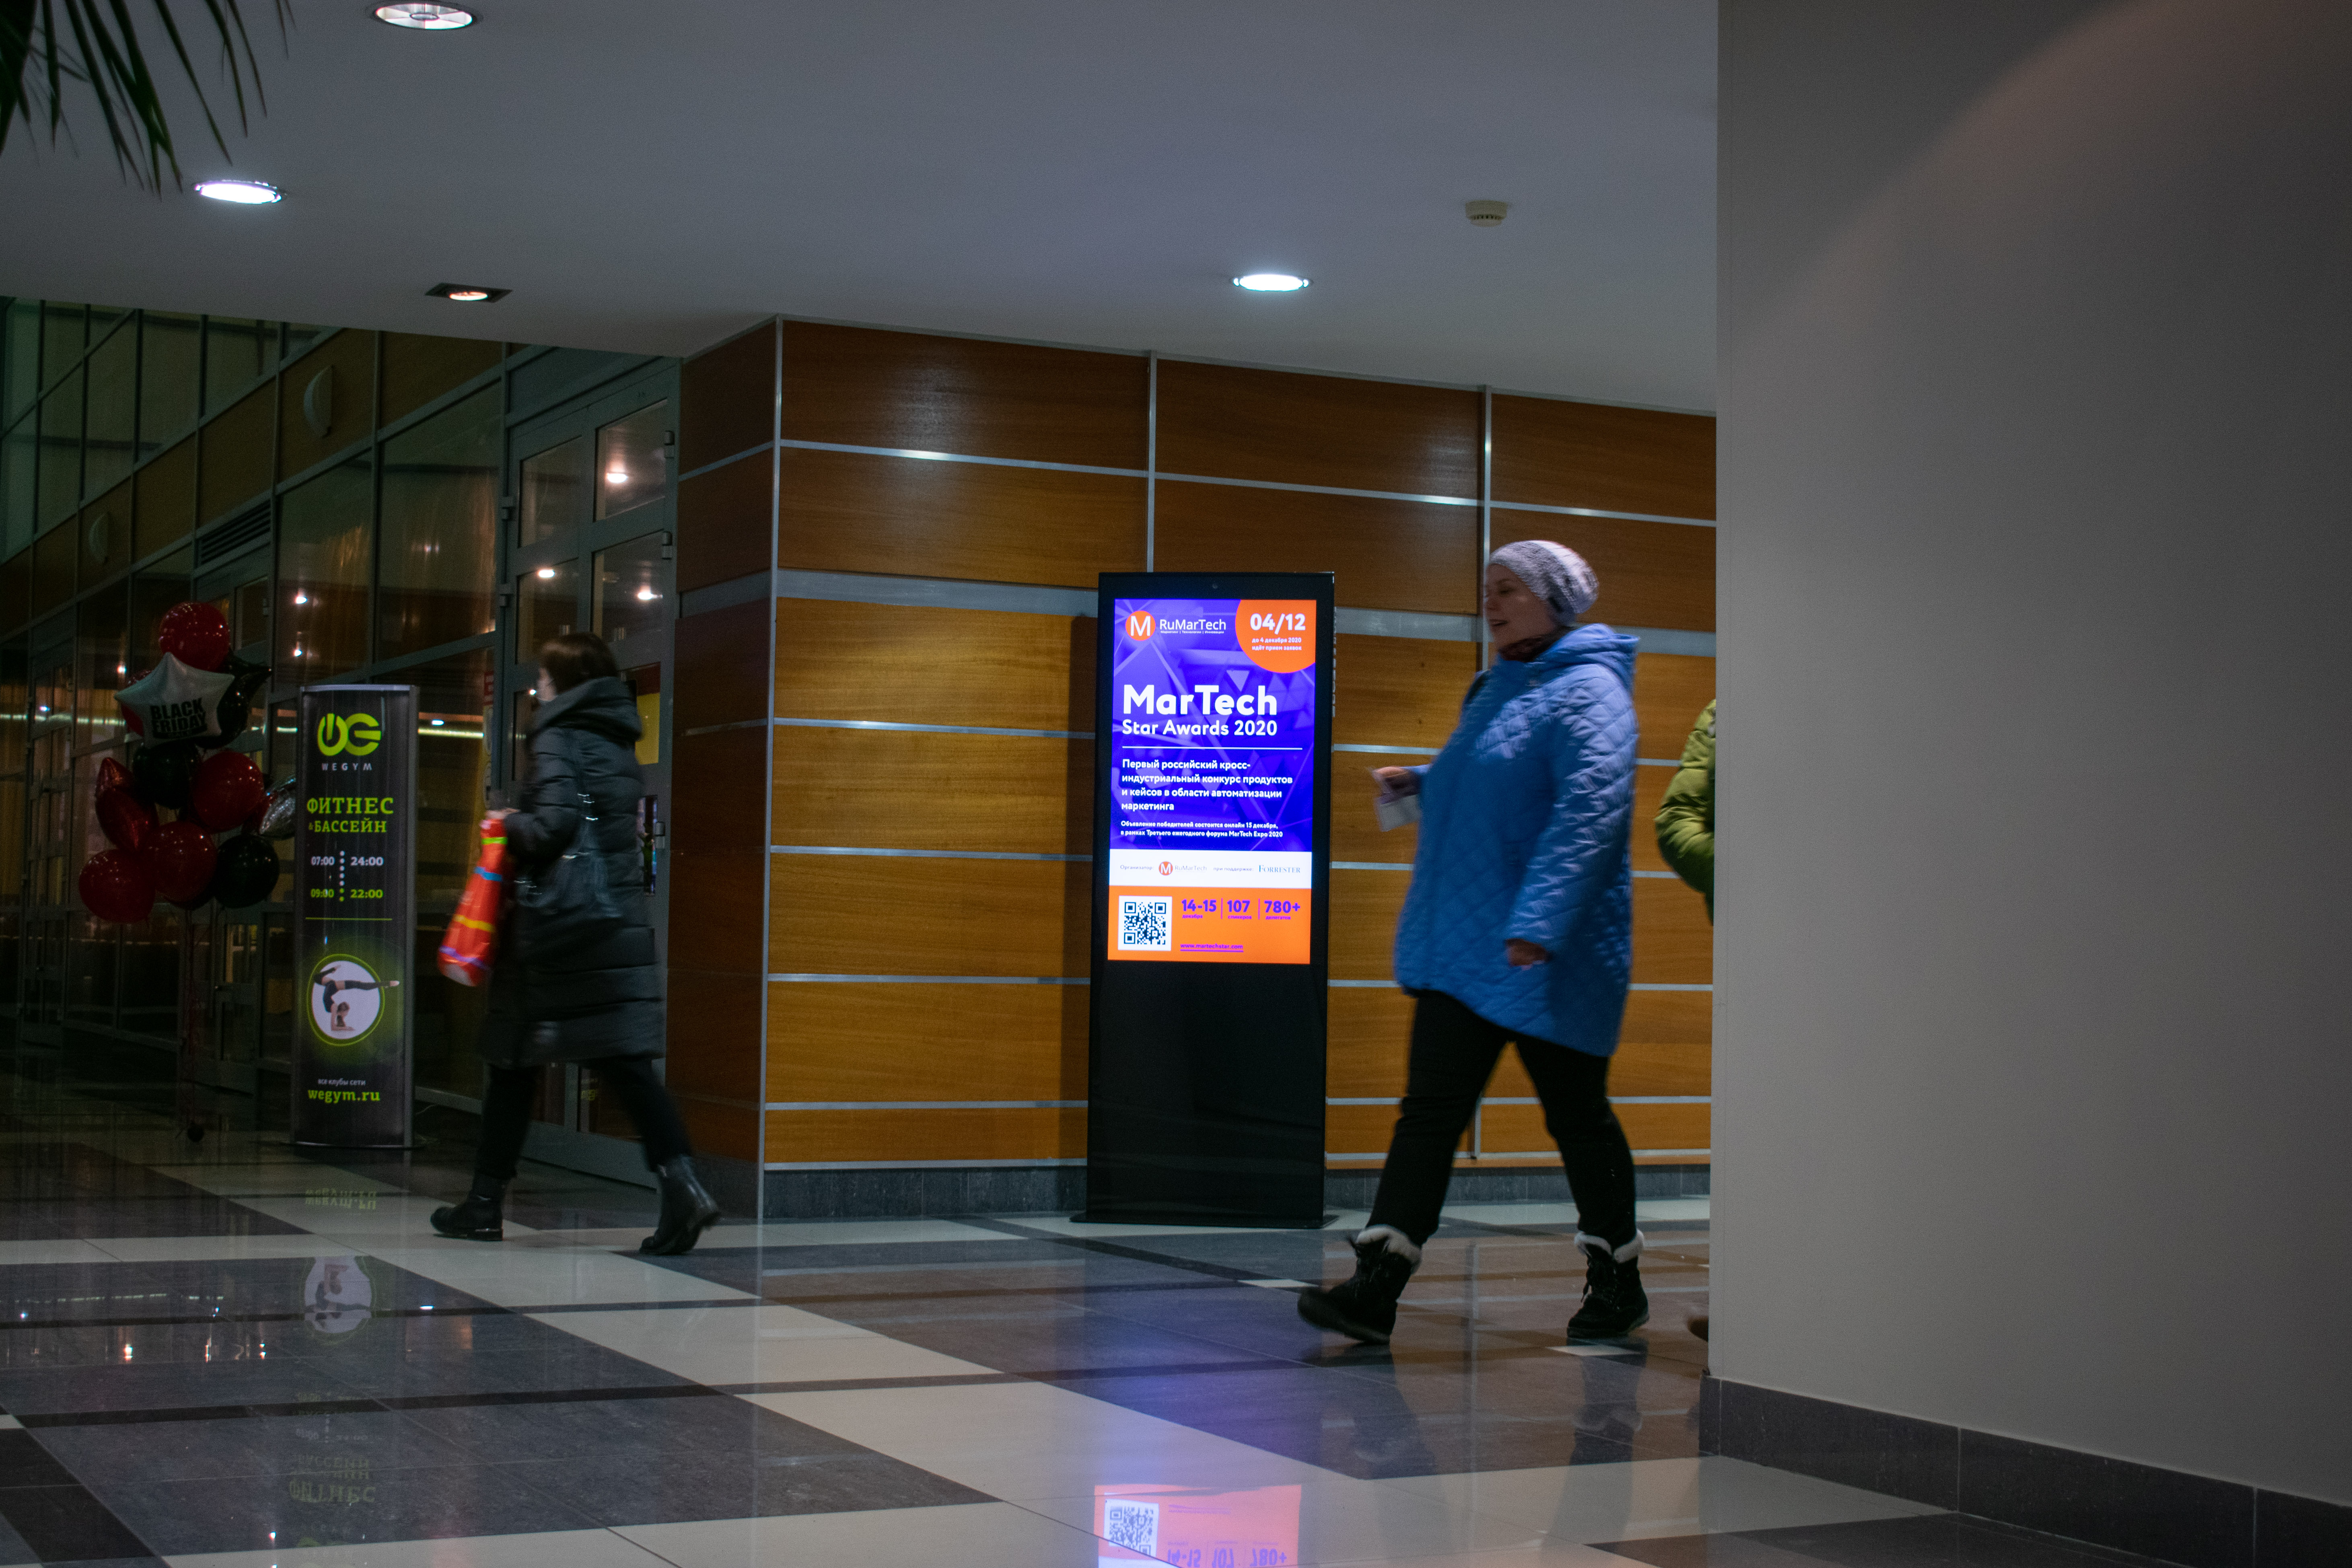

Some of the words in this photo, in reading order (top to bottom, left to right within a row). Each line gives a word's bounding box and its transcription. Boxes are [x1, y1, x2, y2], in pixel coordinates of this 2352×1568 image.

[1130, 615, 1151, 636] M
[1160, 619, 1226, 630] RuMarTech
[1250, 613, 1306, 635] 04/12
[1124, 684, 1277, 715] MarTech
[150, 698, 203, 719] BLACK
[152, 711, 206, 733] FRIDAY
[1122, 719, 1158, 735] Star
[1163, 720, 1229, 735] Awards
[1234, 720, 1277, 736] 2020
[1122, 759, 1159, 769] Первый
[1162, 760, 1218, 770] российский
[1220, 762, 1251, 770] кросс-
[1121, 774, 1200, 784] индустриальный
[1202, 776, 1241, 784] конкурс
[1243, 776, 1293, 784] продуктов
[1172, 788, 1209, 797] области
[1211, 790, 1282, 799] автоматизации
[307, 797, 394, 814] ФИТНЕС
[1121, 803, 1175, 811] маркетинга
[311, 856, 335, 865] 07:00
[351, 857, 384, 866] 24:00
[350, 889, 383, 898] 22:00
[1181, 899, 1216, 912] 14-15
[1226, 899, 1250, 912] 107
[1264, 900, 1300, 914] 780+
[308, 1089, 380, 1103] wegym.ru
